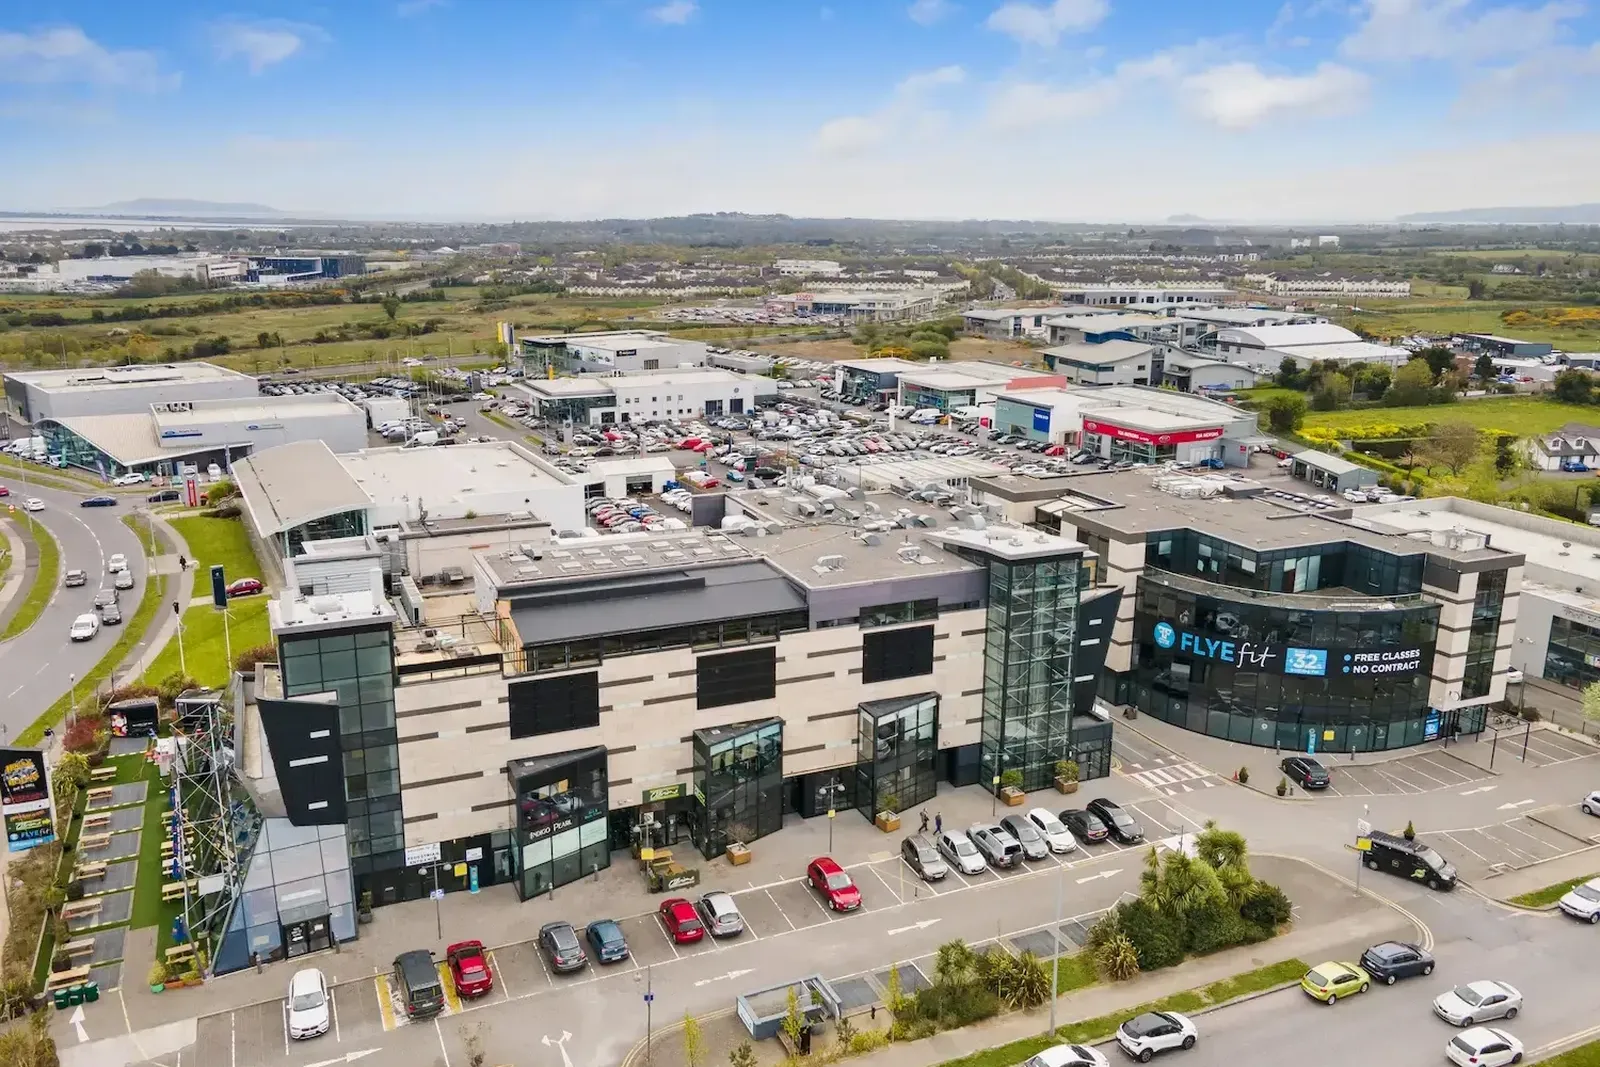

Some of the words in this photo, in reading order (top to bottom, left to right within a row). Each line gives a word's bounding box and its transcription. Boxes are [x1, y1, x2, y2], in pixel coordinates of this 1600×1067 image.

[1180, 632, 1235, 662] FLYE
[1236, 642, 1276, 668] fit
[1354, 653, 1380, 661] FREE
[1382, 649, 1420, 660] CLASSES
[1353, 665, 1369, 673] NO
[1371, 660, 1420, 673] CONTRACT
[529, 826, 551, 840] INDIGO
[553, 819, 572, 831] PEARL
